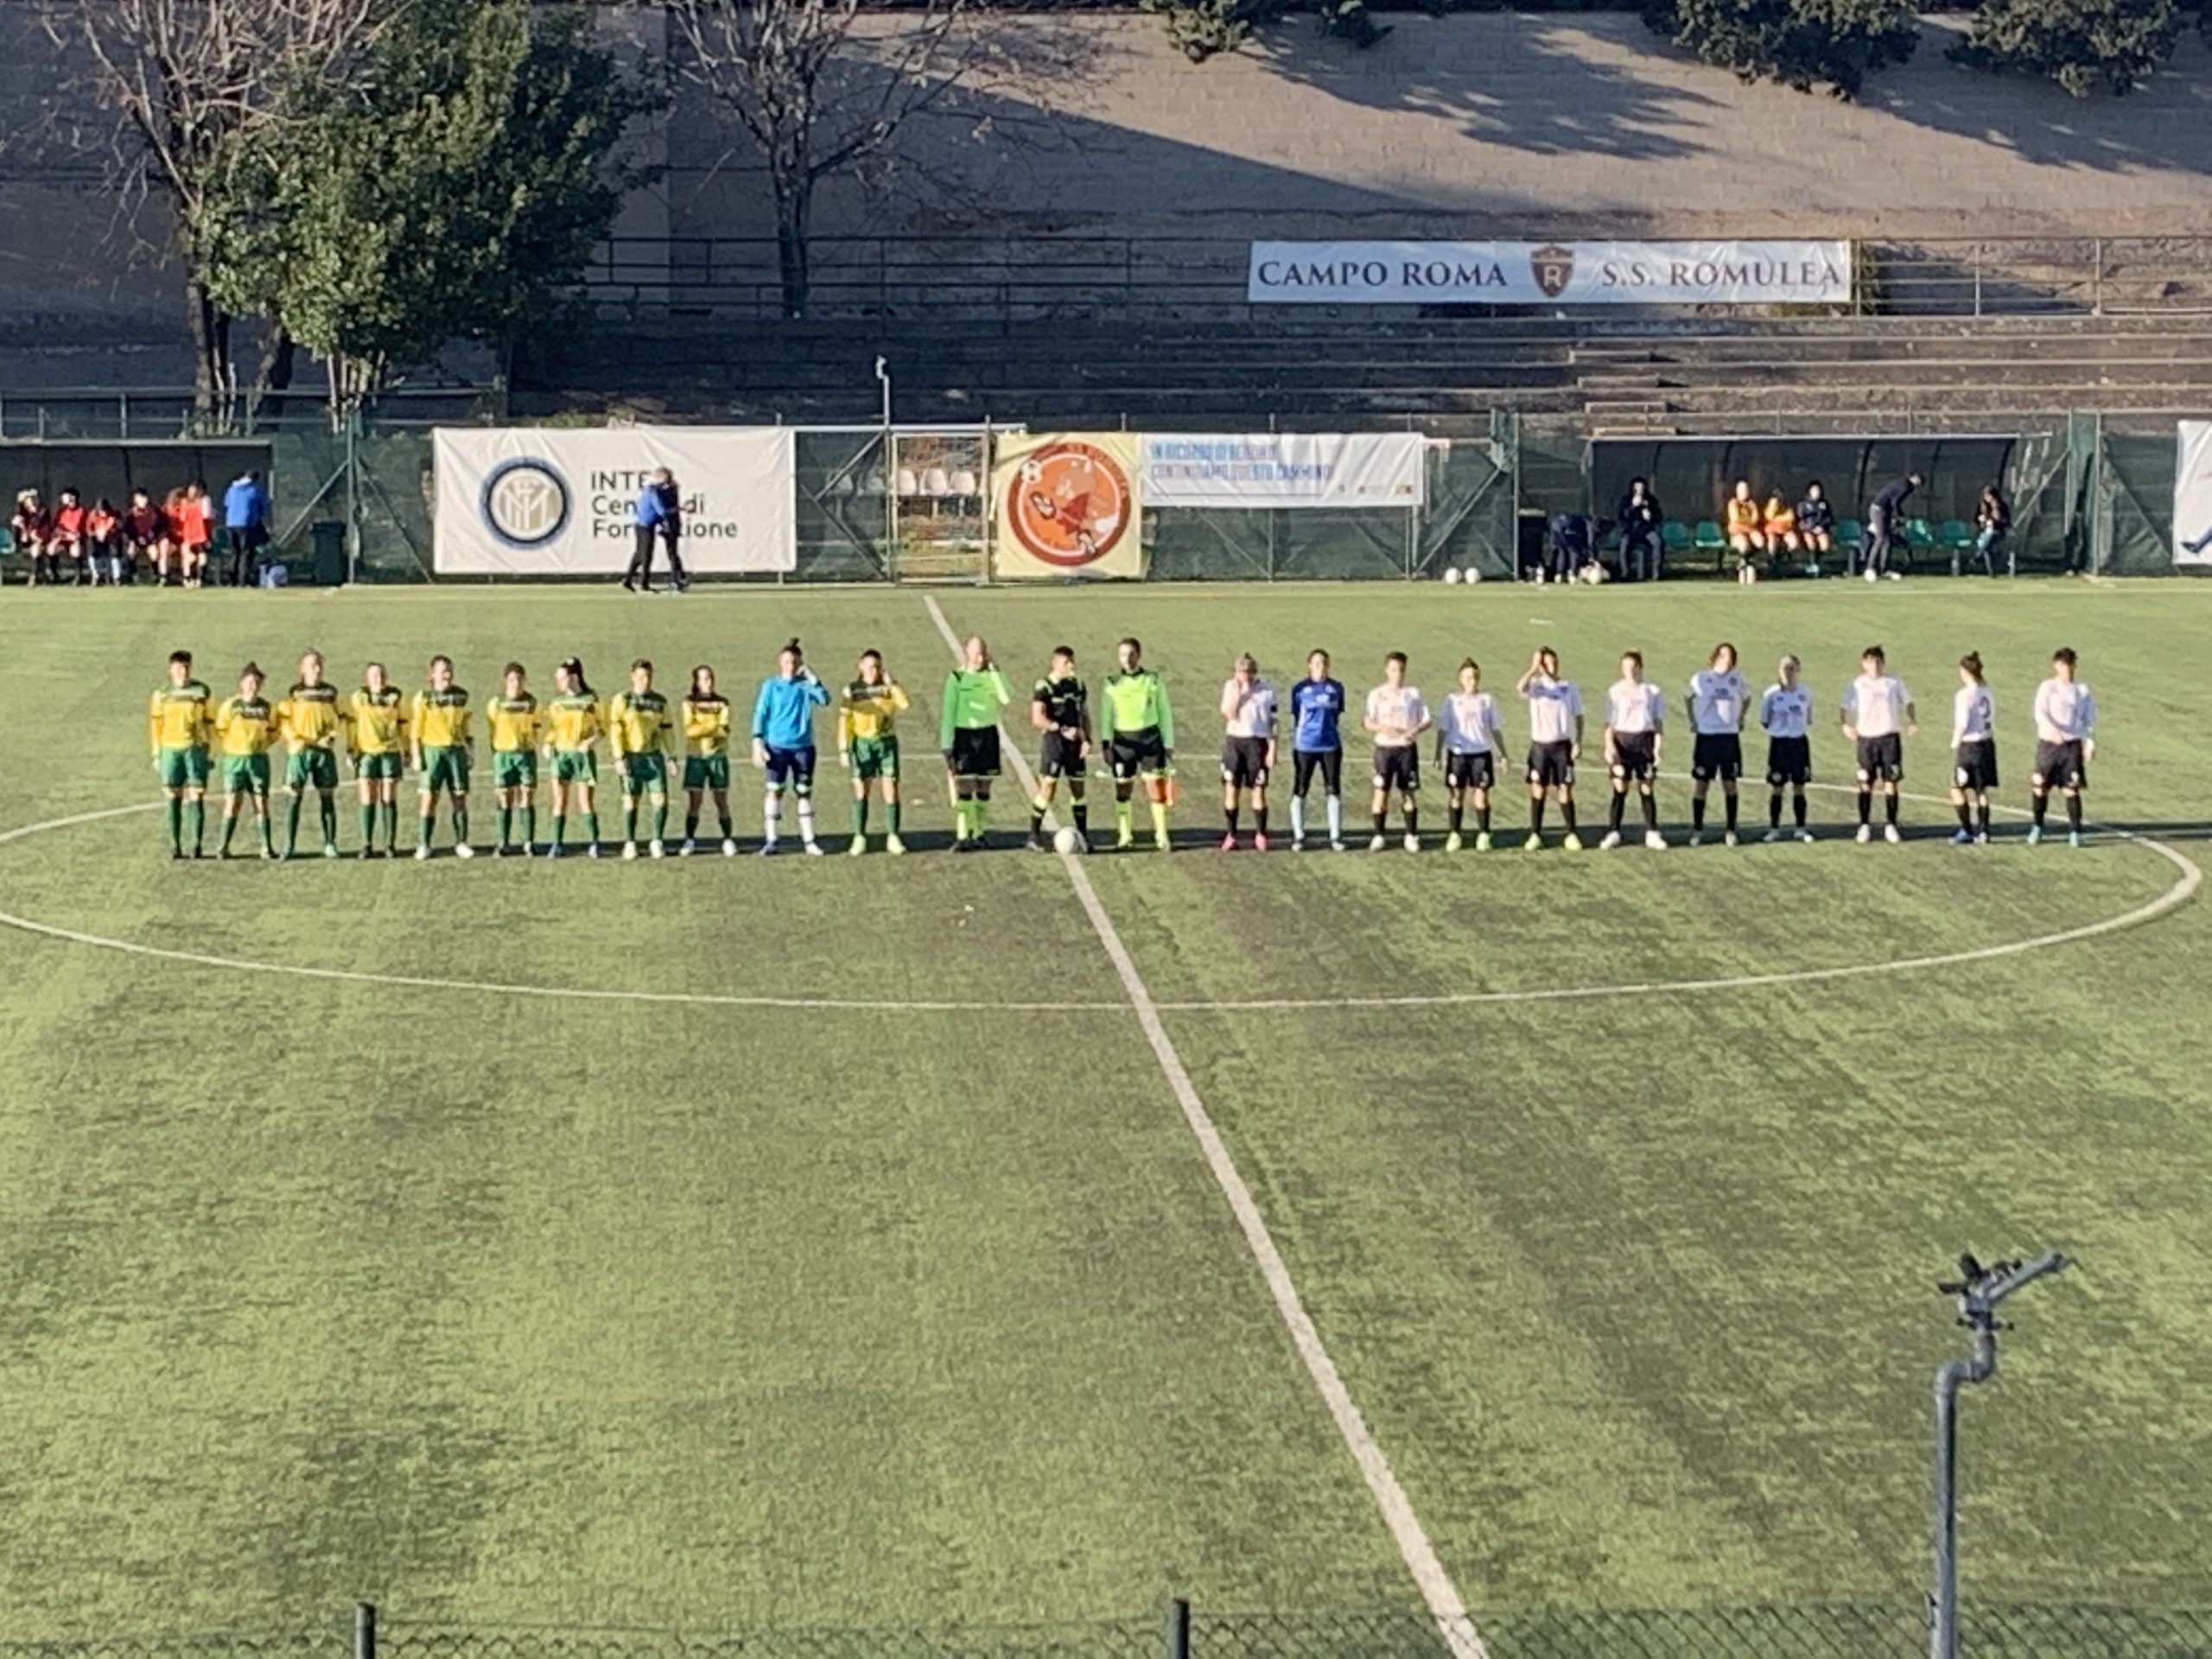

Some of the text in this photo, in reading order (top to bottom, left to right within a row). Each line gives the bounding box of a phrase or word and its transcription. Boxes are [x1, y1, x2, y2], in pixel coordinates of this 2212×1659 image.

[1258, 261, 1508, 287] CAMPO ROMA
[1543, 264, 1562, 288] R
[1602, 261, 1840, 287] S.S. ROMULEA
[590, 470, 652, 491] INTE
[683, 493, 706, 515] di
[593, 518, 738, 538] Forione
